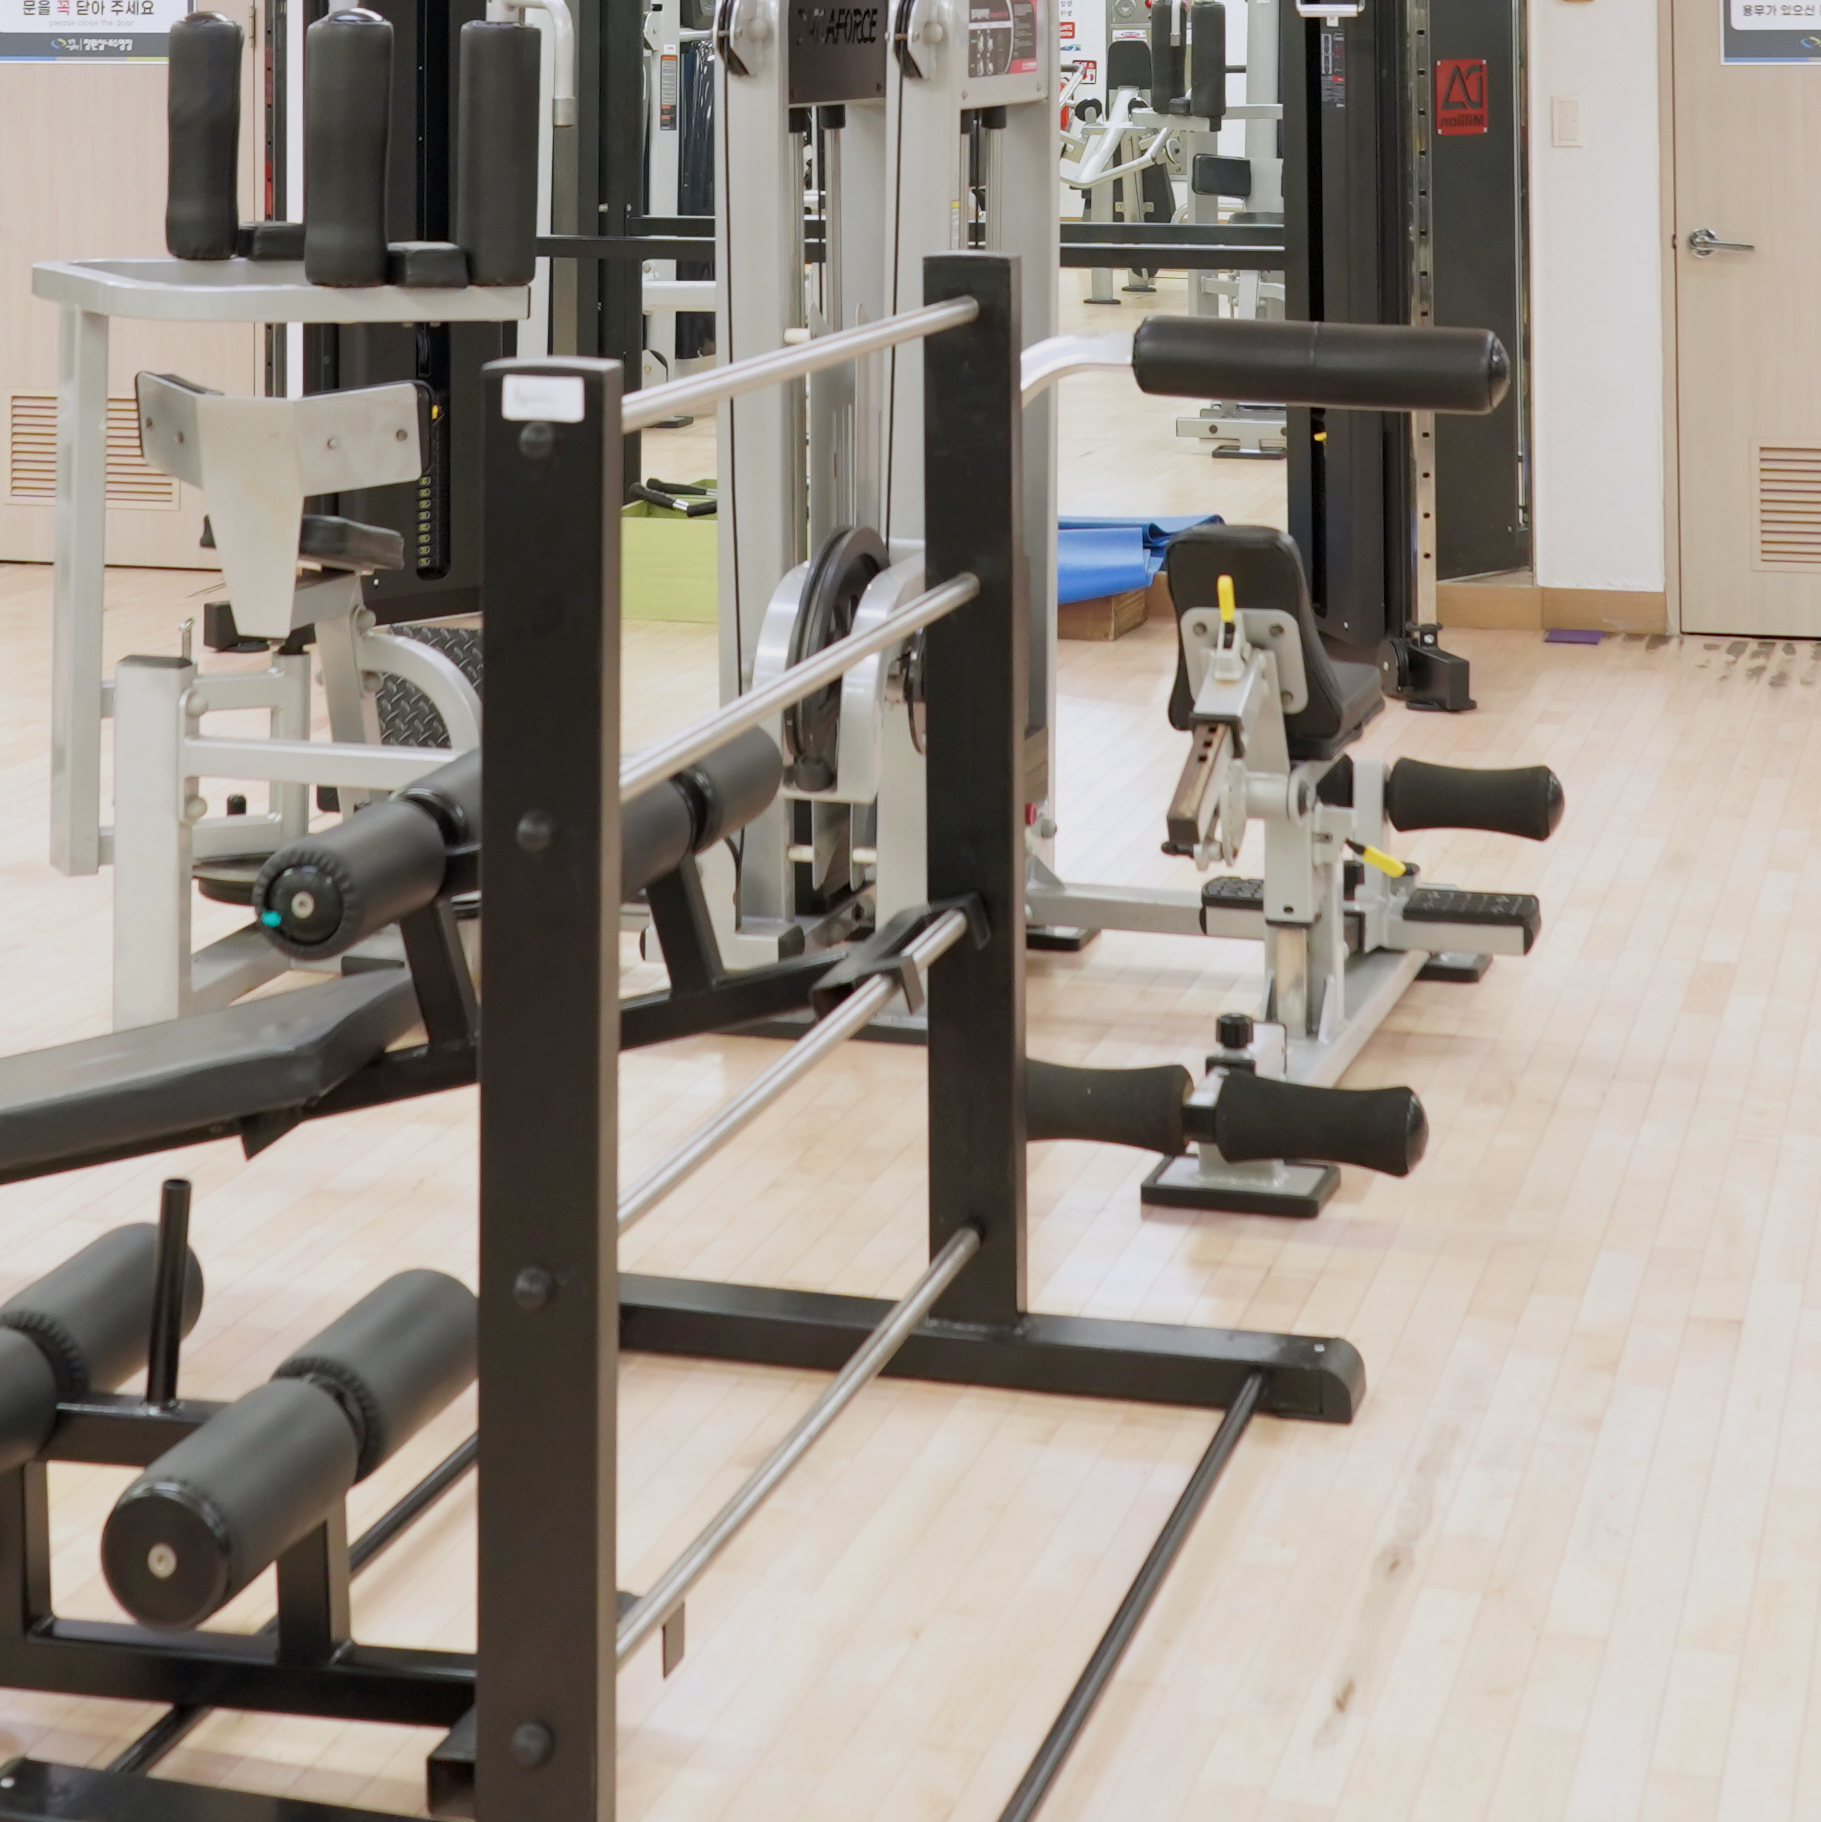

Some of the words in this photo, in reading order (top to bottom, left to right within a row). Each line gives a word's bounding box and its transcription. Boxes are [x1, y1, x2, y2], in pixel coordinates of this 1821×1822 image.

[23, 0, 51, 16] 문을
[57, 0, 70, 15] 꼭
[77, 0, 105, 15] 닫아
[111, 0, 155, 15] 주세요
[1742, 5, 1777, 17] 용무가
[49, 20, 76, 28] please
[78, 19, 99, 27] close
[101, 19, 114, 27] the
[116, 19, 134, 27] door
